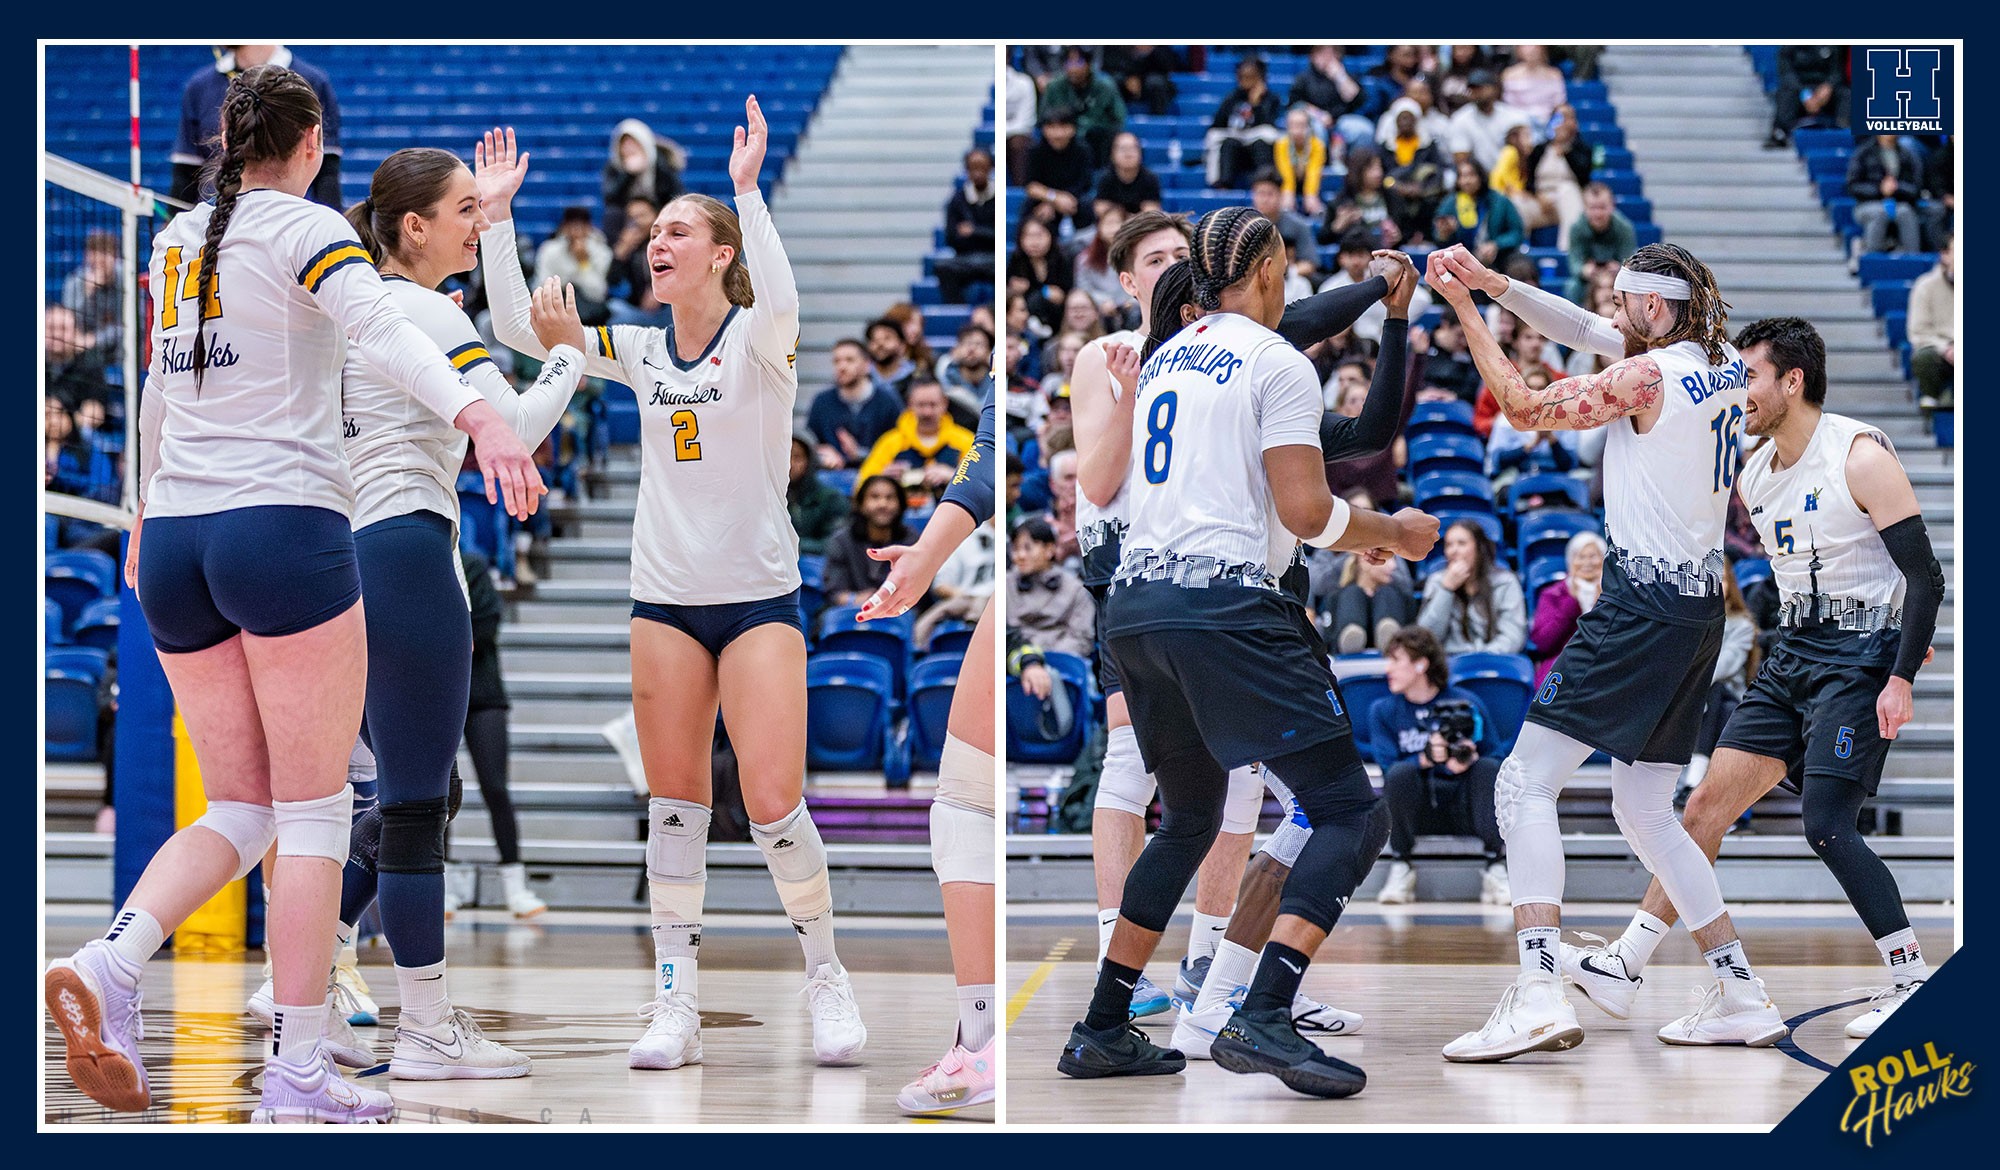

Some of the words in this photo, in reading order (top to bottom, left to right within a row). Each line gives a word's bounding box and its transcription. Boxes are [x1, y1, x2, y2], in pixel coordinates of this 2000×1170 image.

[161, 245, 224, 331] 14
[649, 381, 722, 406] Humber
[670, 409, 702, 462] 2
[1144, 389, 1178, 486] 8
[1710, 403, 1743, 494] 16
[1774, 518, 1795, 556] 5
[1834, 726, 1855, 759] 5
